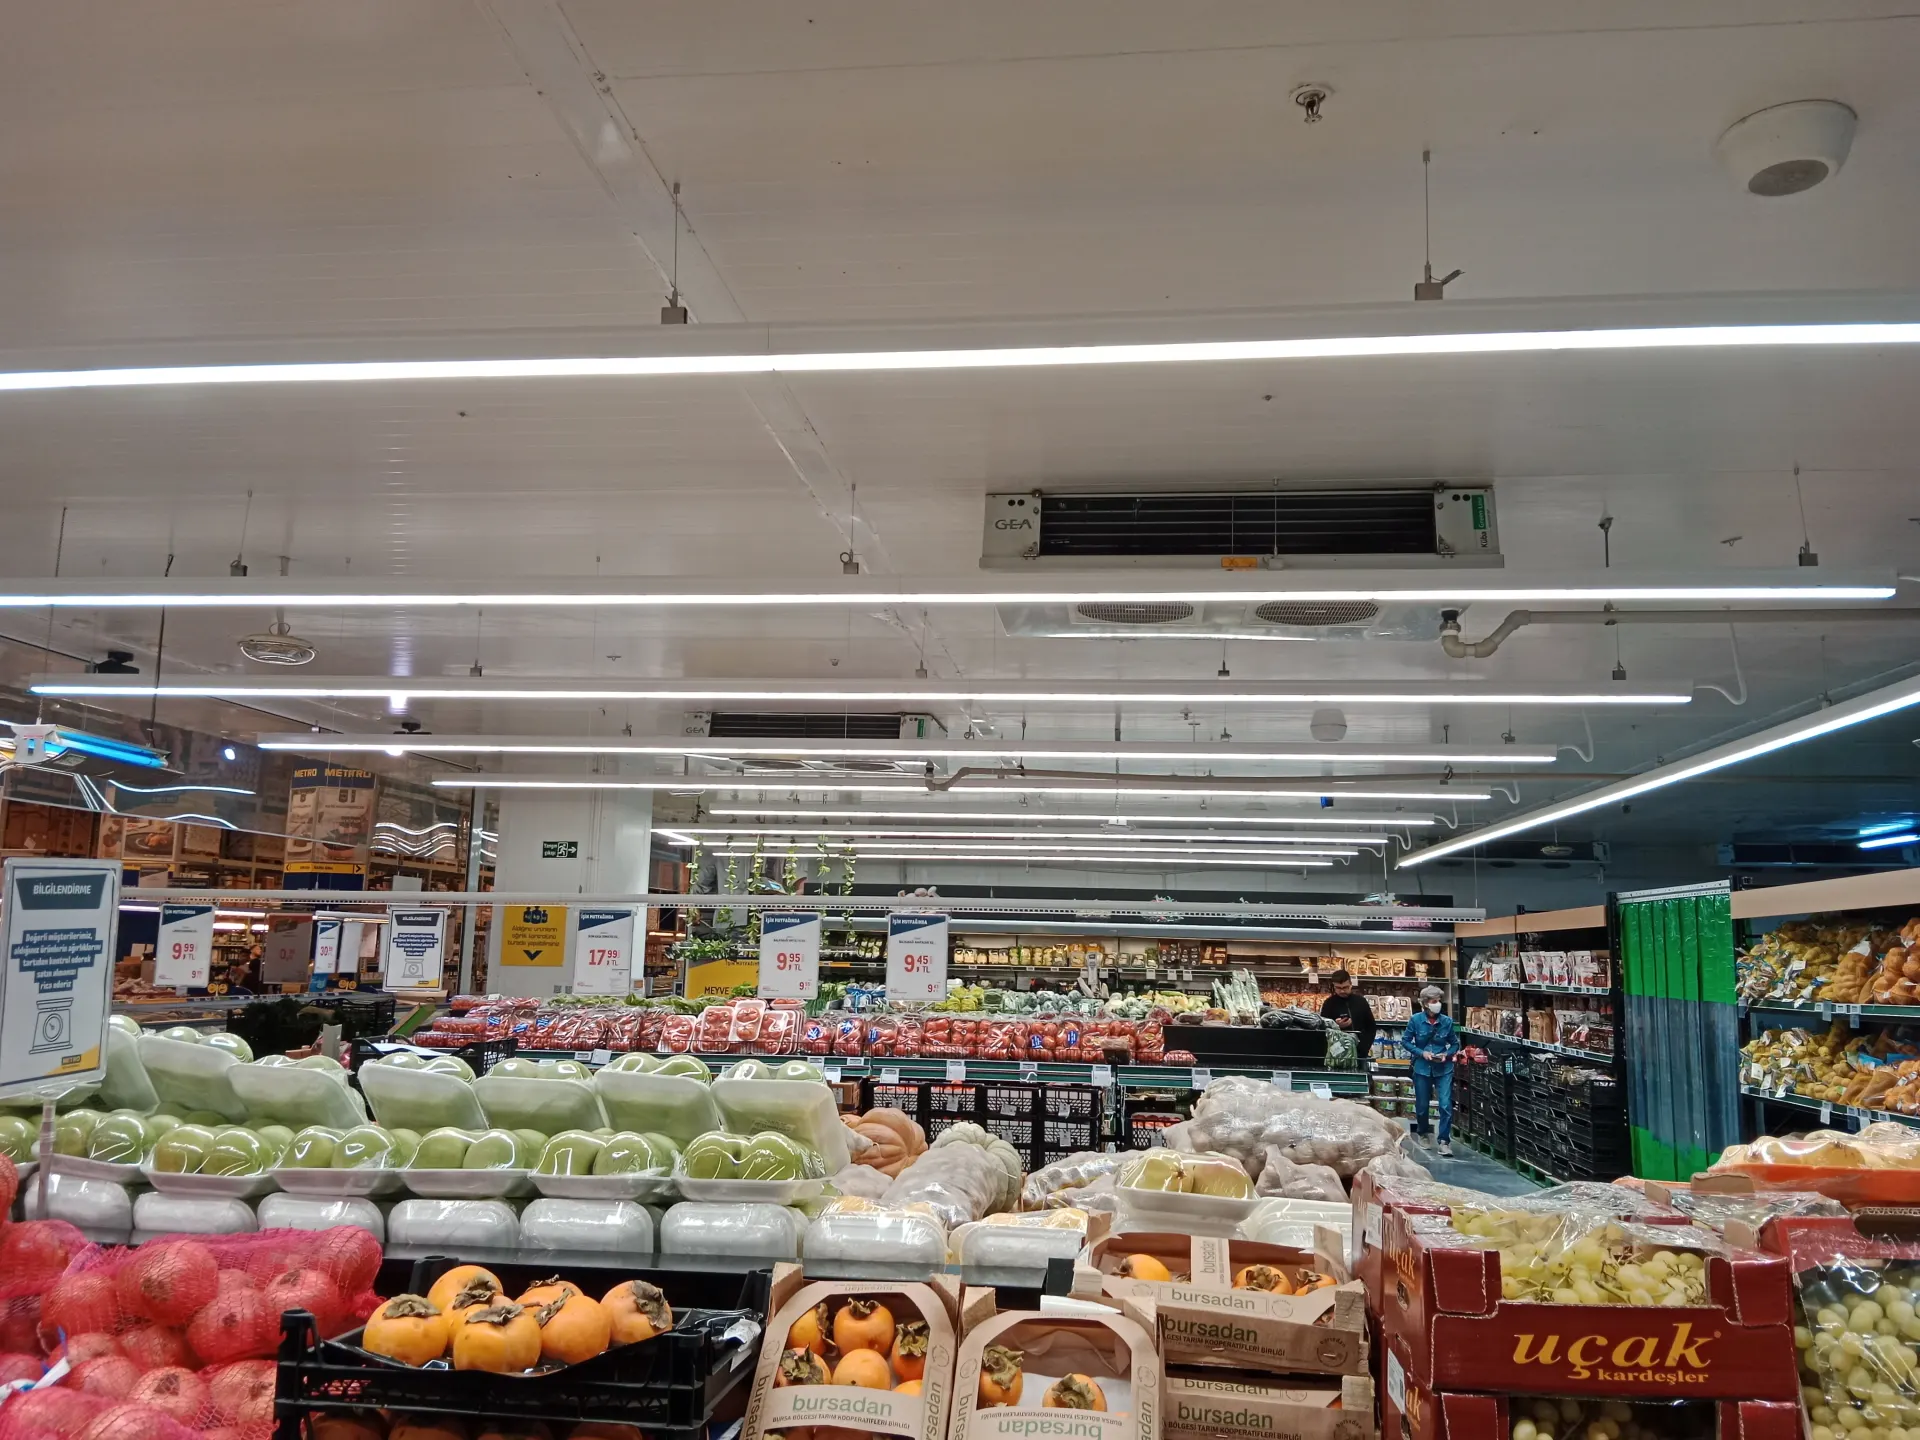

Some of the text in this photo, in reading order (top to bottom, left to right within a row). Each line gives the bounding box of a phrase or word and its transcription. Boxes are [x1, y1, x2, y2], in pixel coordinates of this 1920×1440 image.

[994, 518, 1033, 531] GEA
[685, 726, 705, 735] GEA
[294, 767, 318, 778] METRO
[33, 882, 92, 895] BİLGİLENDİRME
[25, 931, 48, 944] Değerli
[704, 986, 730, 995] MEYVE
[1170, 1288, 1256, 1311] bursadan
[1161, 1312, 1258, 1344] bursadan
[1183, 1336, 1204, 1344] TARIM
[1260, 1346, 1286, 1357] BİRLİĞİ
[1512, 1322, 1714, 1380] uçak
[1597, 1368, 1709, 1386] kardeşler
[792, 1394, 893, 1418] bursadan
[772, 1414, 792, 1423] BURSA
[1177, 1401, 1274, 1430] bursadan
[998, 1419, 1103, 1440] bursadan
[1168, 1420, 1197, 1431] BÖLGESİ
[1198, 1424, 1219, 1433] TARIM
